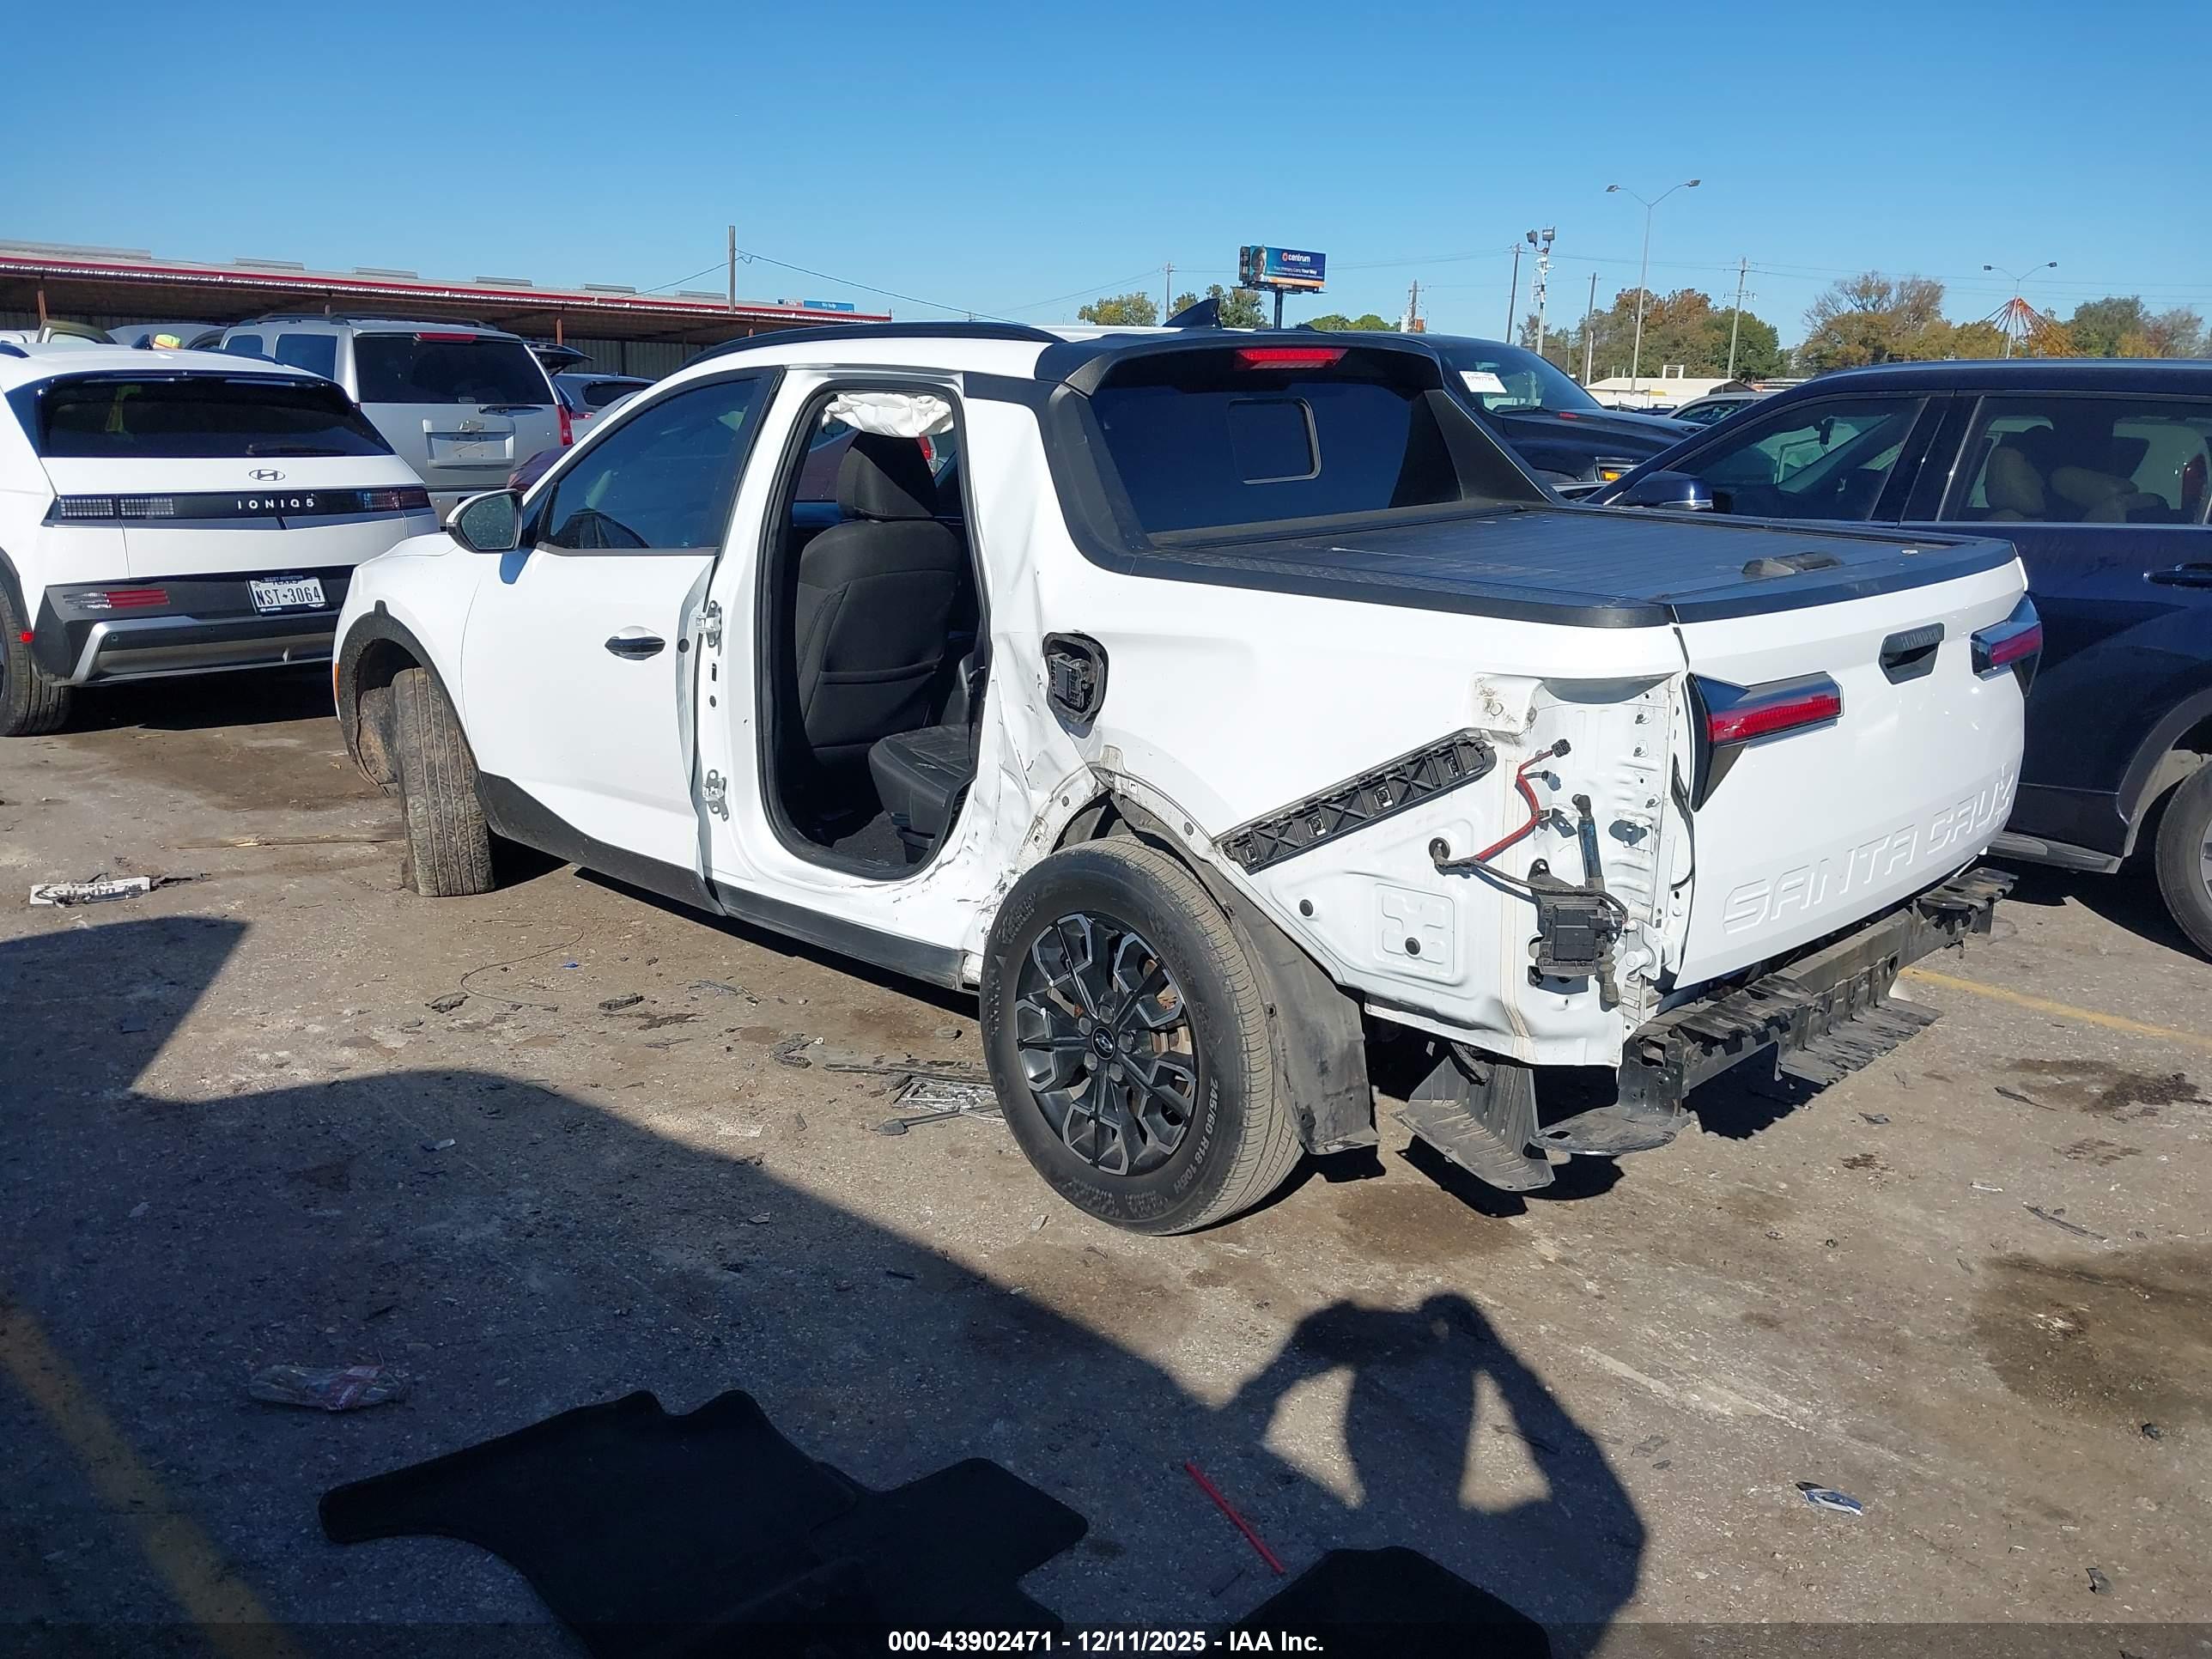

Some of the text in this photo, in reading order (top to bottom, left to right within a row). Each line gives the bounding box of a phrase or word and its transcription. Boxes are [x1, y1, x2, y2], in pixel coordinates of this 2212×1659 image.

[1288, 253, 1311, 263] centrum
[1723, 762, 2015, 935] SANTA CRUZ
[1205, 1076, 1219, 1135] 245/60
[1194, 1134, 1210, 1164] R18
[1173, 1163, 1198, 1194] 105H
